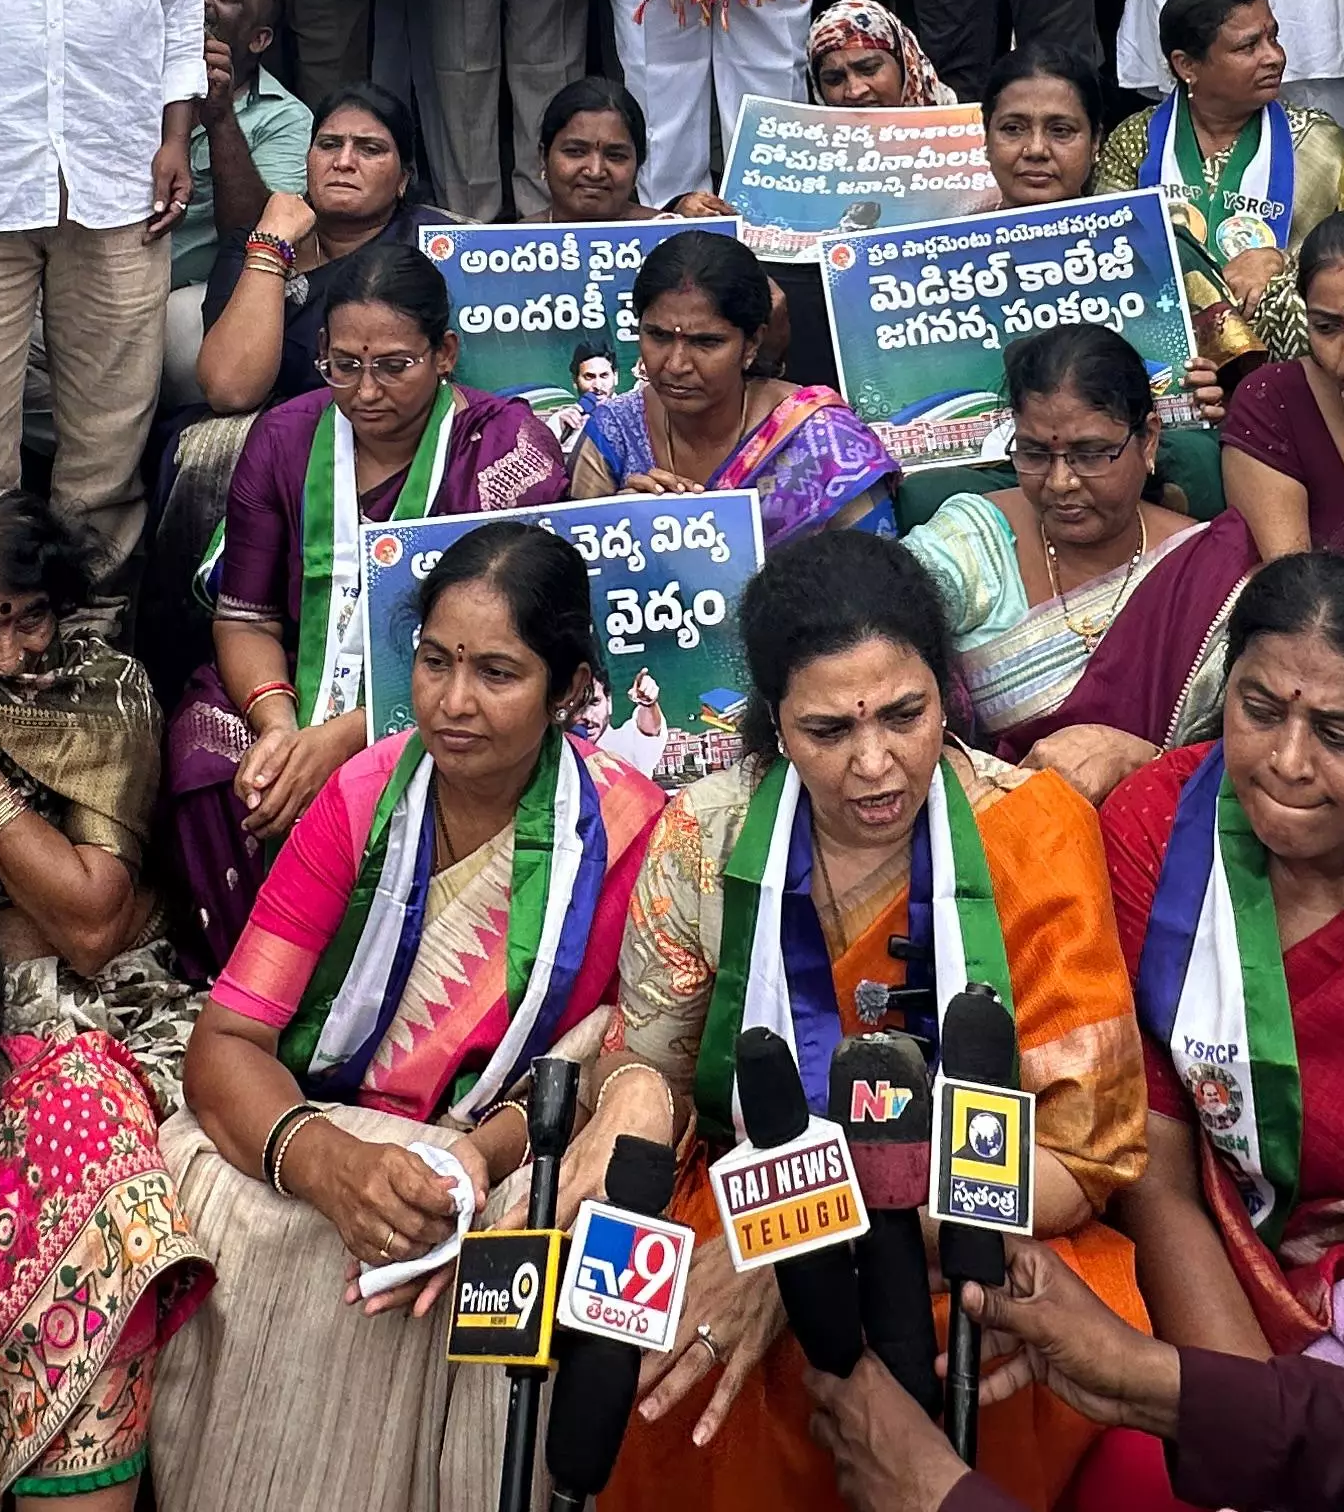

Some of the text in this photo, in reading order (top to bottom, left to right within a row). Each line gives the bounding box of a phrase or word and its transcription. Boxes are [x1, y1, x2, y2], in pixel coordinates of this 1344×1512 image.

[756, 116, 830, 149] ప్రభుత్వ
[831, 124, 875, 148] వైద్య
[1223, 190, 1285, 220] YSRCP
[460, 232, 581, 274] అందరికీ
[867, 205, 1134, 266] ప్రతి పార్లమెంటు నియోజకవర్గంలో
[868, 235, 1135, 312] మెడికల్ కాలేజీ
[458, 282, 607, 334] అందరికీ
[875, 290, 1145, 351] జగనన్న సంకల్పం
[649, 510, 731, 564] విద్య
[605, 579, 727, 656] వైద్యం
[1183, 1035, 1239, 1065] YSRCP
[727, 1144, 844, 1208] RAJ NEWS
[951, 1182, 1017, 1220] స్వతంత్ర
[739, 1190, 854, 1263] TELUGU
[577, 1234, 679, 1305] TV9
[586, 1294, 649, 1334] తెలుగు
